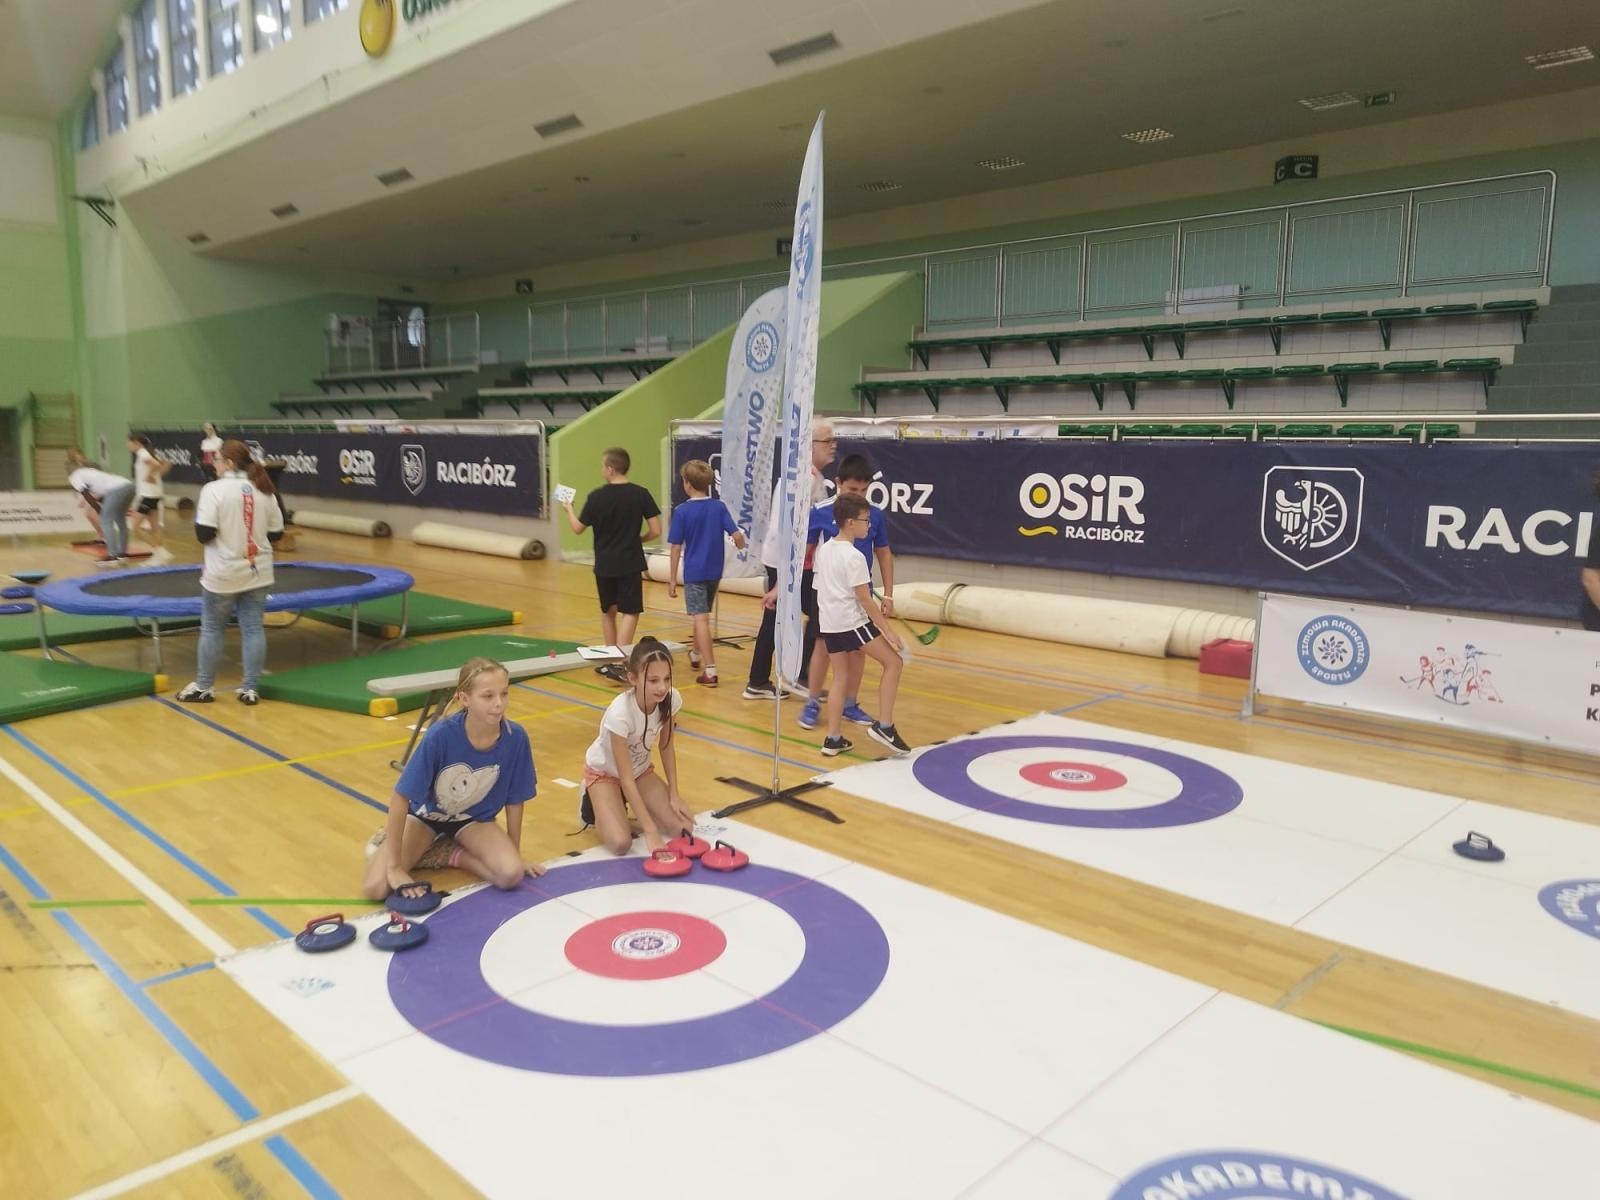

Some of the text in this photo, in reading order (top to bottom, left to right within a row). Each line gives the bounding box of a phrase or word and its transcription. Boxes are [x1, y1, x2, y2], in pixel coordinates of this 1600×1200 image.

[436, 456, 517, 487] RACIBÓRZ
[1065, 524, 1145, 544] RACIBÓRZ
[1302, 619, 1365, 664] ZIMOWA AKADEMIA
[1311, 665, 1351, 681] SPORTU
